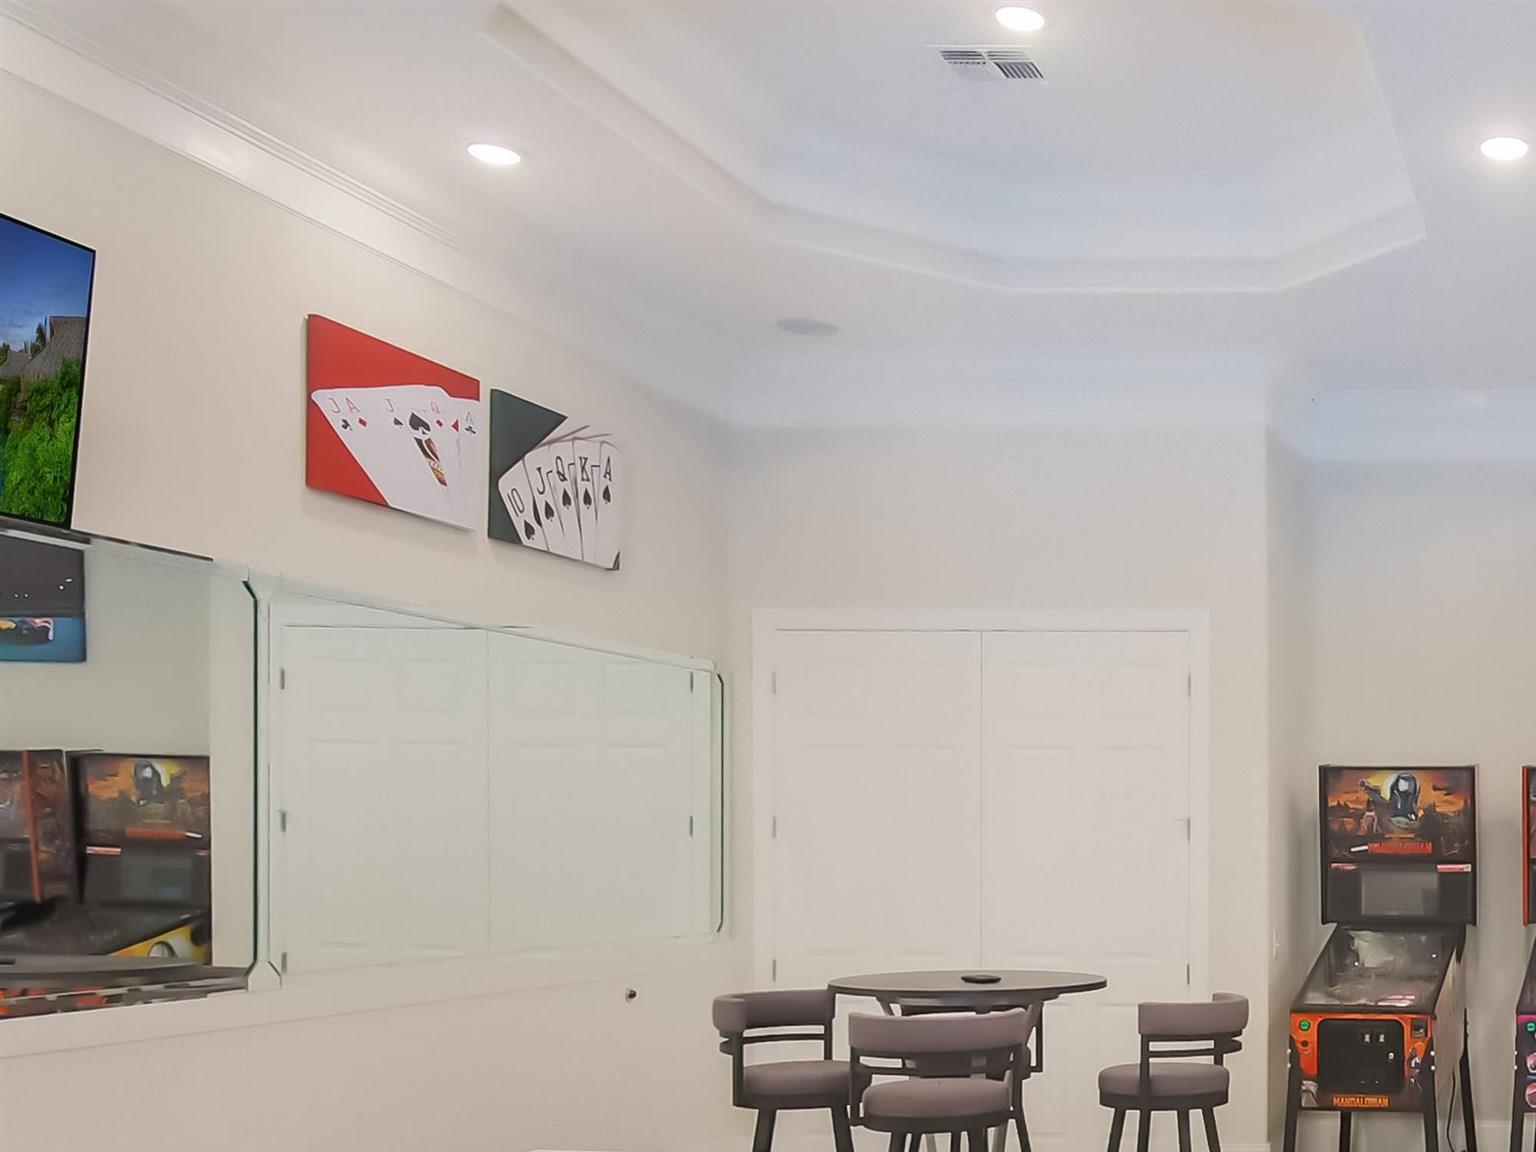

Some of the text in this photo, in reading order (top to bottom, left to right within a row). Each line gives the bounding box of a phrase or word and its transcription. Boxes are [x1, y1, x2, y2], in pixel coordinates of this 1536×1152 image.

[345, 397, 361, 414] A
[506, 455, 613, 518] 10 J Q K A
